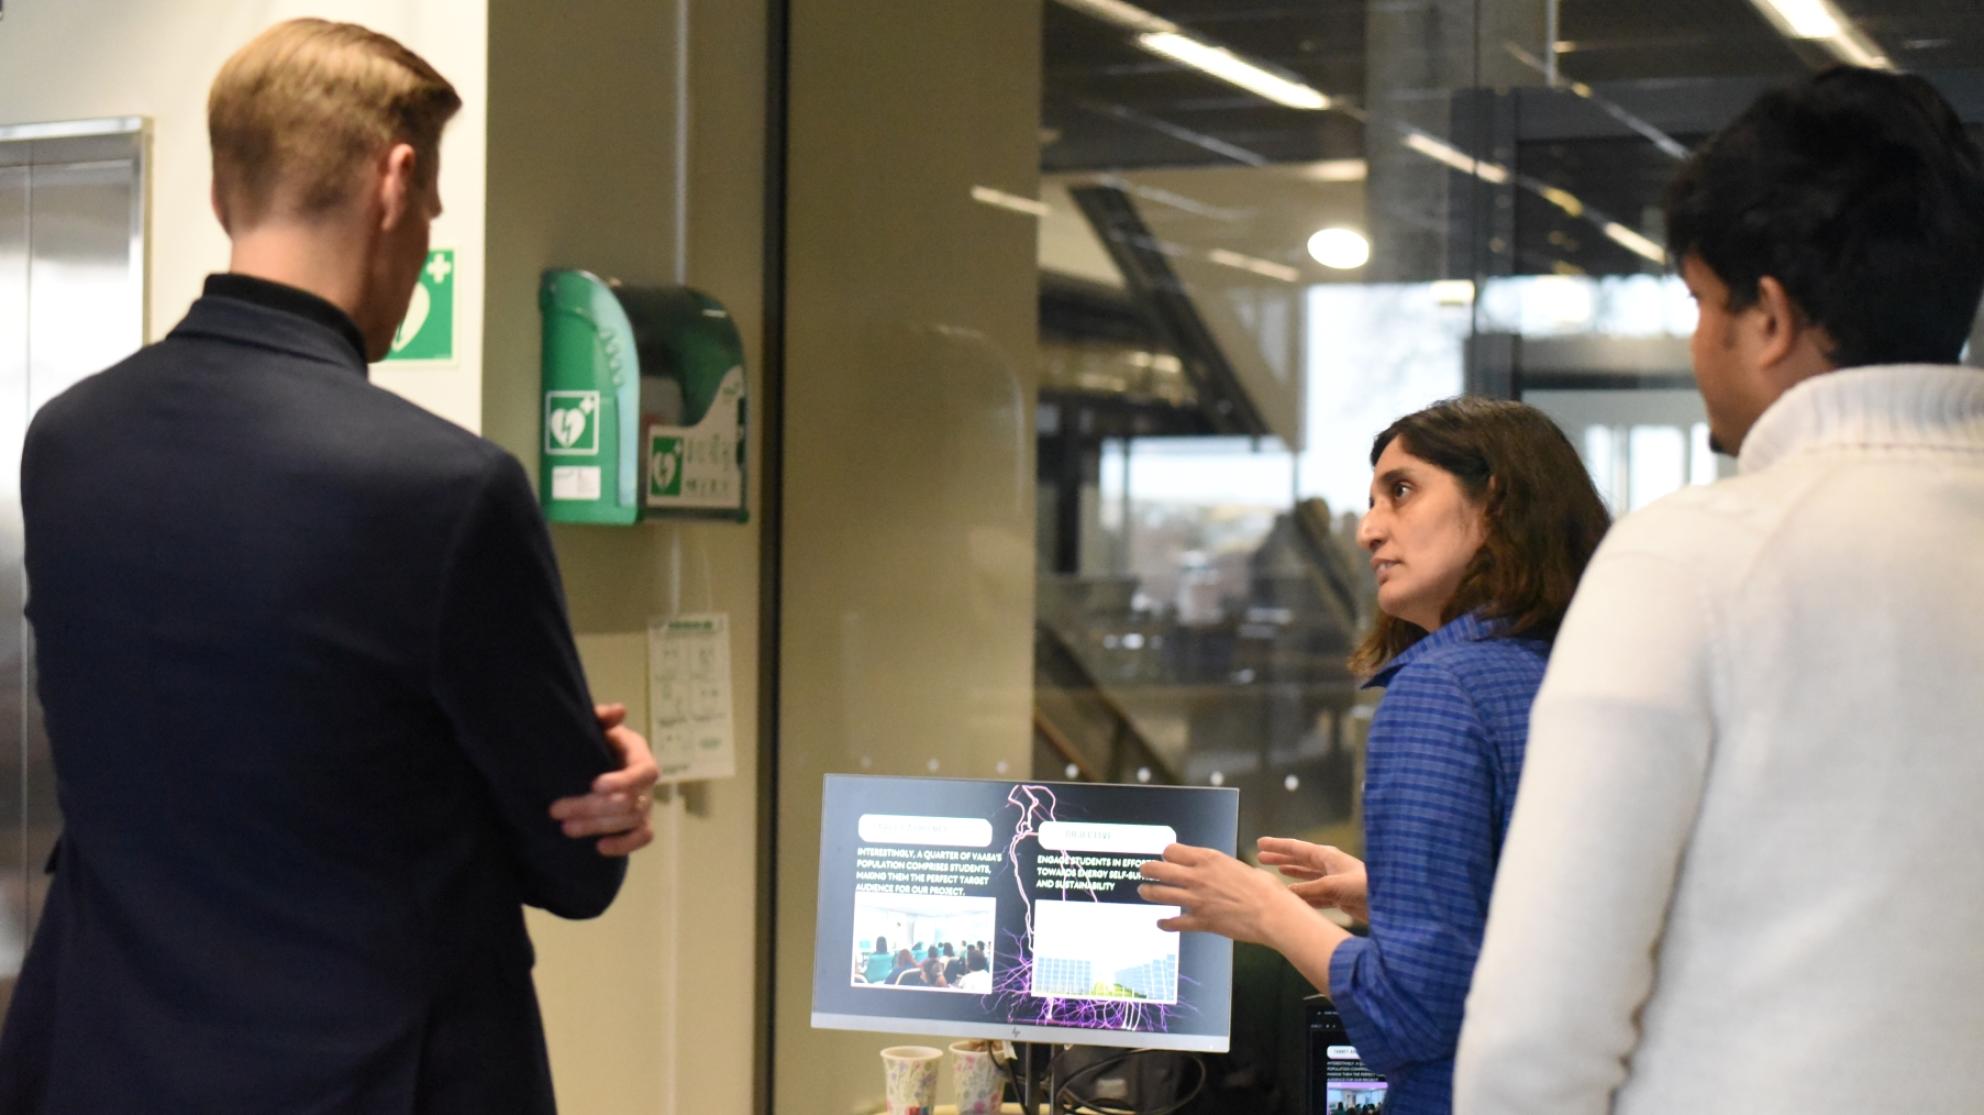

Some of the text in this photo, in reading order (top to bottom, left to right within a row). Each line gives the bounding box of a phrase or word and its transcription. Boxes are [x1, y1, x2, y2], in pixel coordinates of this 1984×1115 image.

[857, 848, 1002, 862] INTERESTINGLY, A QUARTER OF VAASA'S
[1037, 855, 1071, 865] ENGAGE
[1072, 857, 1112, 867] STUDENTS
[1113, 859, 1121, 867] IN
[856, 860, 991, 874] POPULATION COMPRISES STUDENTS,
[856, 872, 989, 885] MAKING THEM THE PERFECT TARGET
[1037, 868, 1077, 877] TOWARDS
[1078, 869, 1108, 879] ENERGY
[856, 884, 894, 893] AUDIENCE
[895, 885, 910, 894] FOR
[911, 886, 928, 894] OUR
[1036, 880, 1115, 891] AND SUSTAINABILITY
